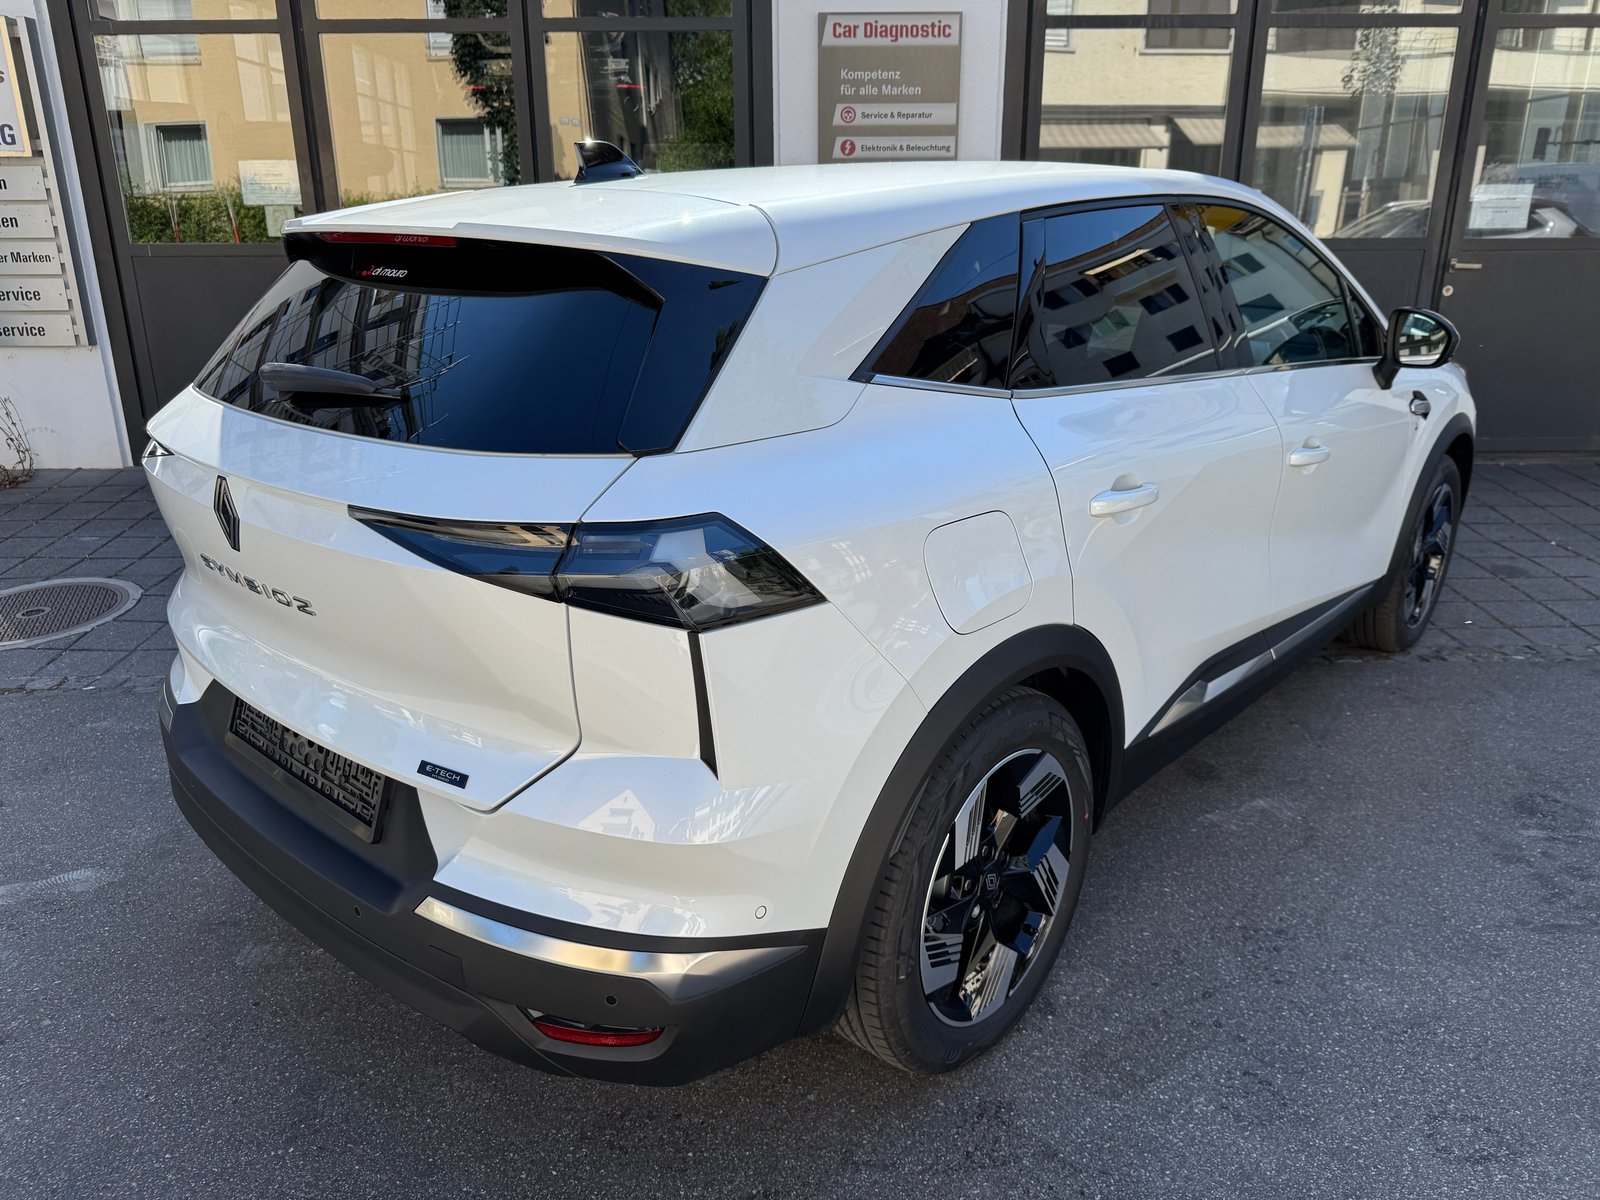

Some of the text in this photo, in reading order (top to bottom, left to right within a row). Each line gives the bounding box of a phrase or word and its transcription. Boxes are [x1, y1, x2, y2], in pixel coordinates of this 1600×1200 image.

[832, 20, 952, 42] Car Diagnostic
[840, 68, 901, 81] Kompetenz
[840, 84, 922, 95] für alle Marken
[860, 111, 933, 120] Service & Reparatur
[860, 144, 951, 153] Elektronik & Beleuchtung
[0, 216, 19, 228] en
[10, 251, 52, 263] Marken
[200, 553, 317, 616] SYMBIOZ
